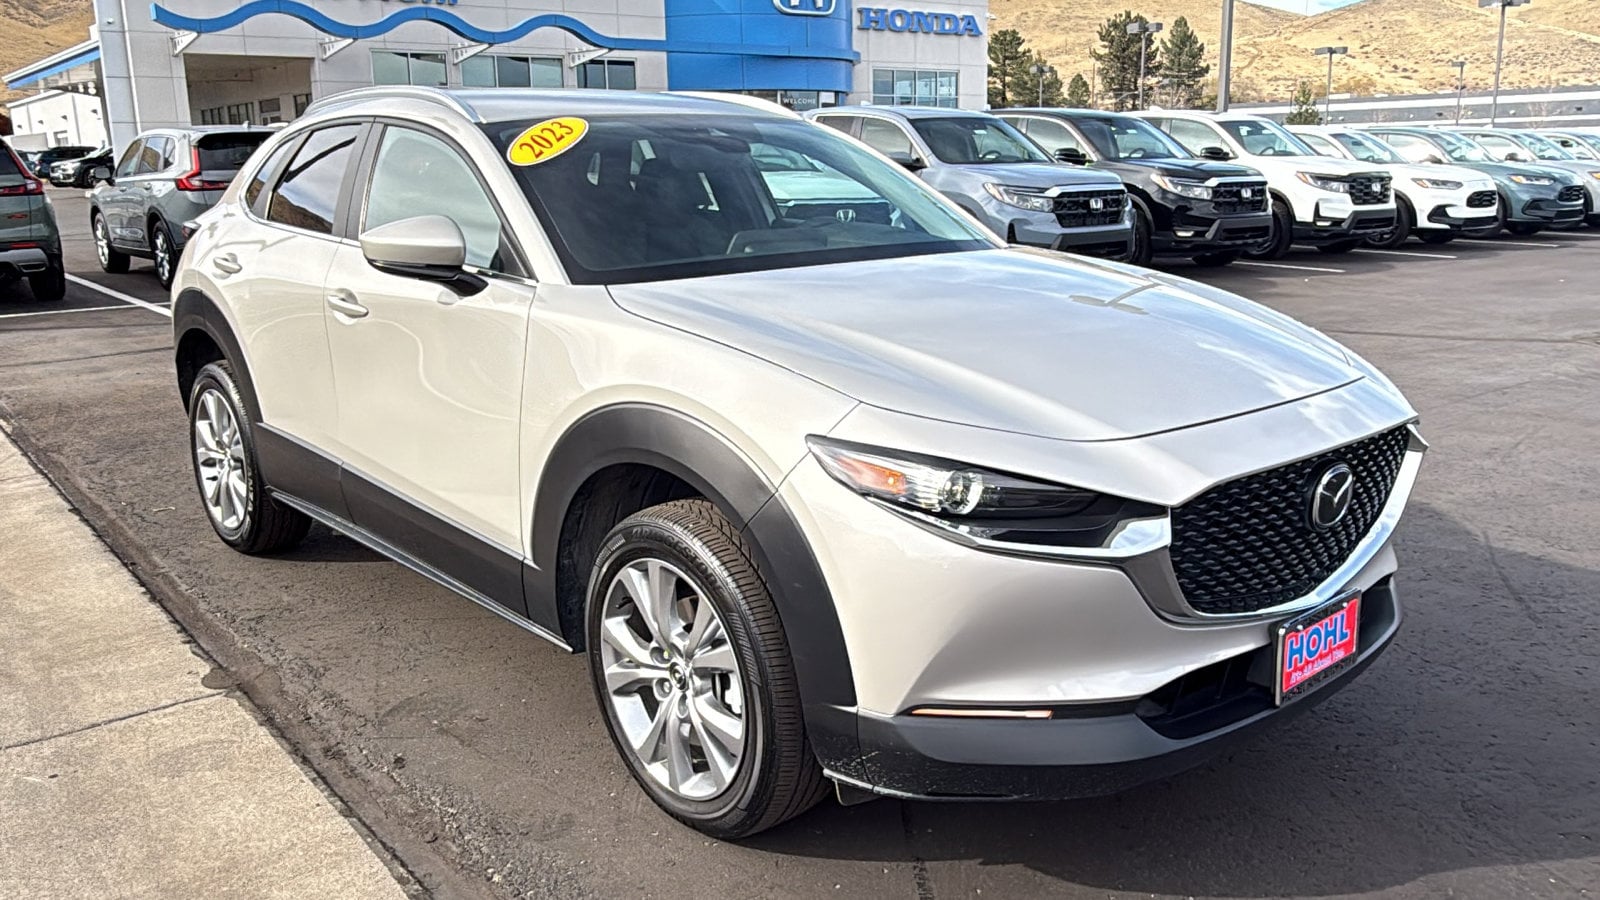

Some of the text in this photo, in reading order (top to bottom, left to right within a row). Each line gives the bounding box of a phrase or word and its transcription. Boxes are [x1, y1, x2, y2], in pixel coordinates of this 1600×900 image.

[857, 8, 982, 36] HONDA
[520, 122, 573, 158] 2023
[1287, 613, 1349, 670] HOHL
